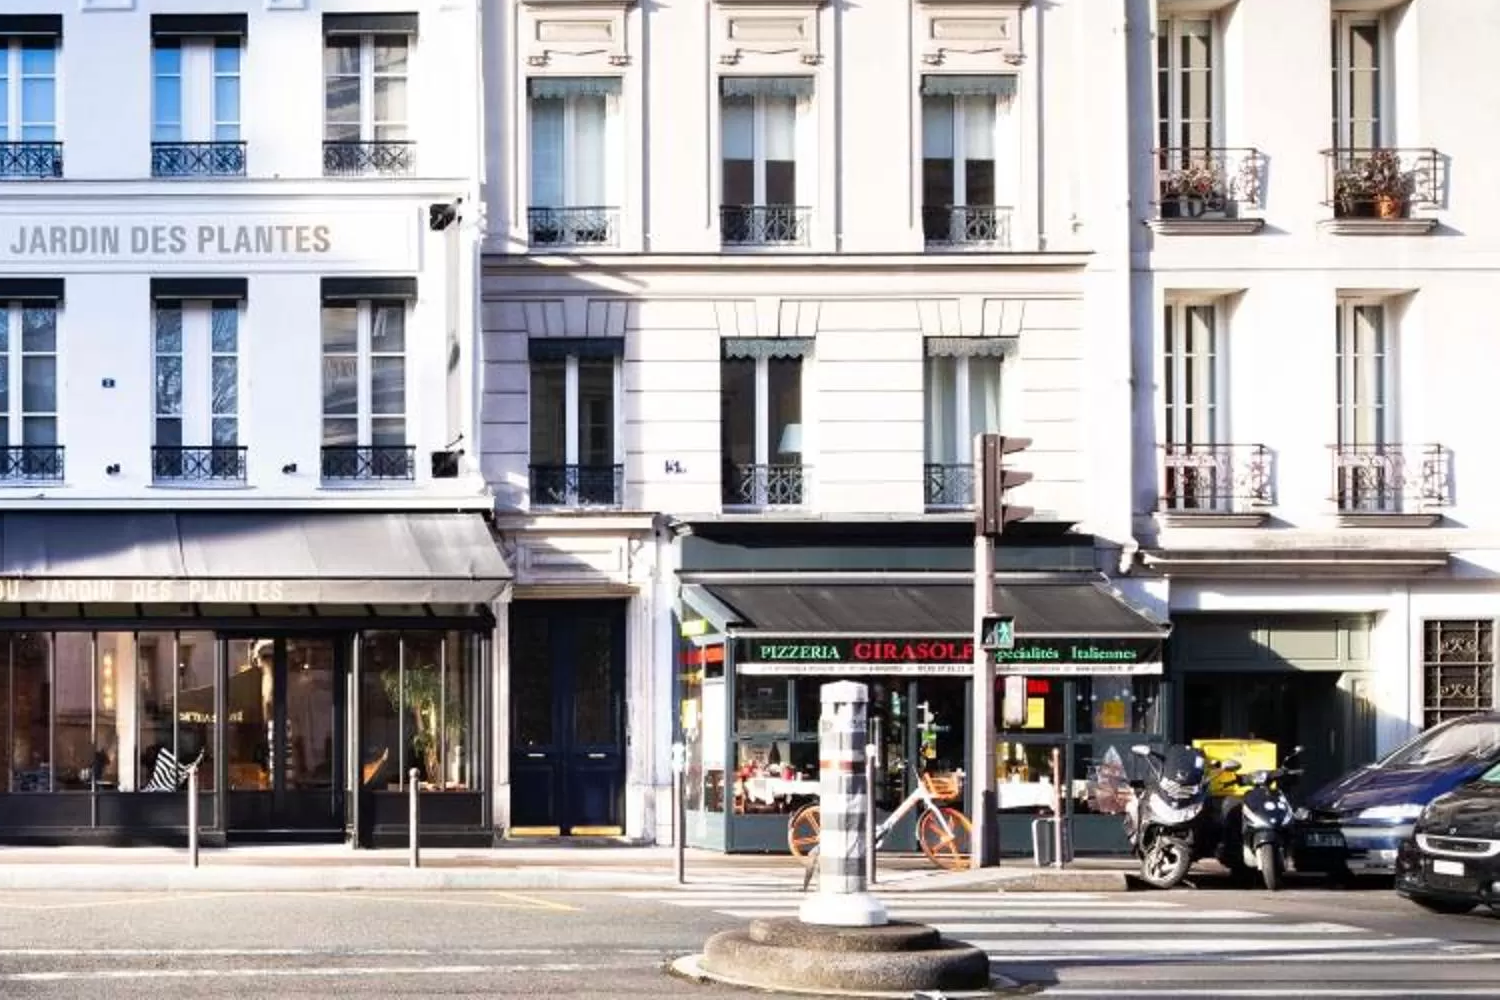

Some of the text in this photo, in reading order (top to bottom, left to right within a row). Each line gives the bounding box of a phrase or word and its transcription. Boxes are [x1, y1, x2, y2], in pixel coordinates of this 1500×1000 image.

[9, 225, 119, 255] JARDIN
[130, 225, 187, 254] DES
[197, 225, 332, 254] PLANTES
[36, 580, 115, 601] JARDIN
[134, 580, 173, 601] DES
[188, 580, 285, 601] PLANTES
[760, 644, 840, 660] PIZZERIA
[1071, 645, 1138, 660] Italiennes
